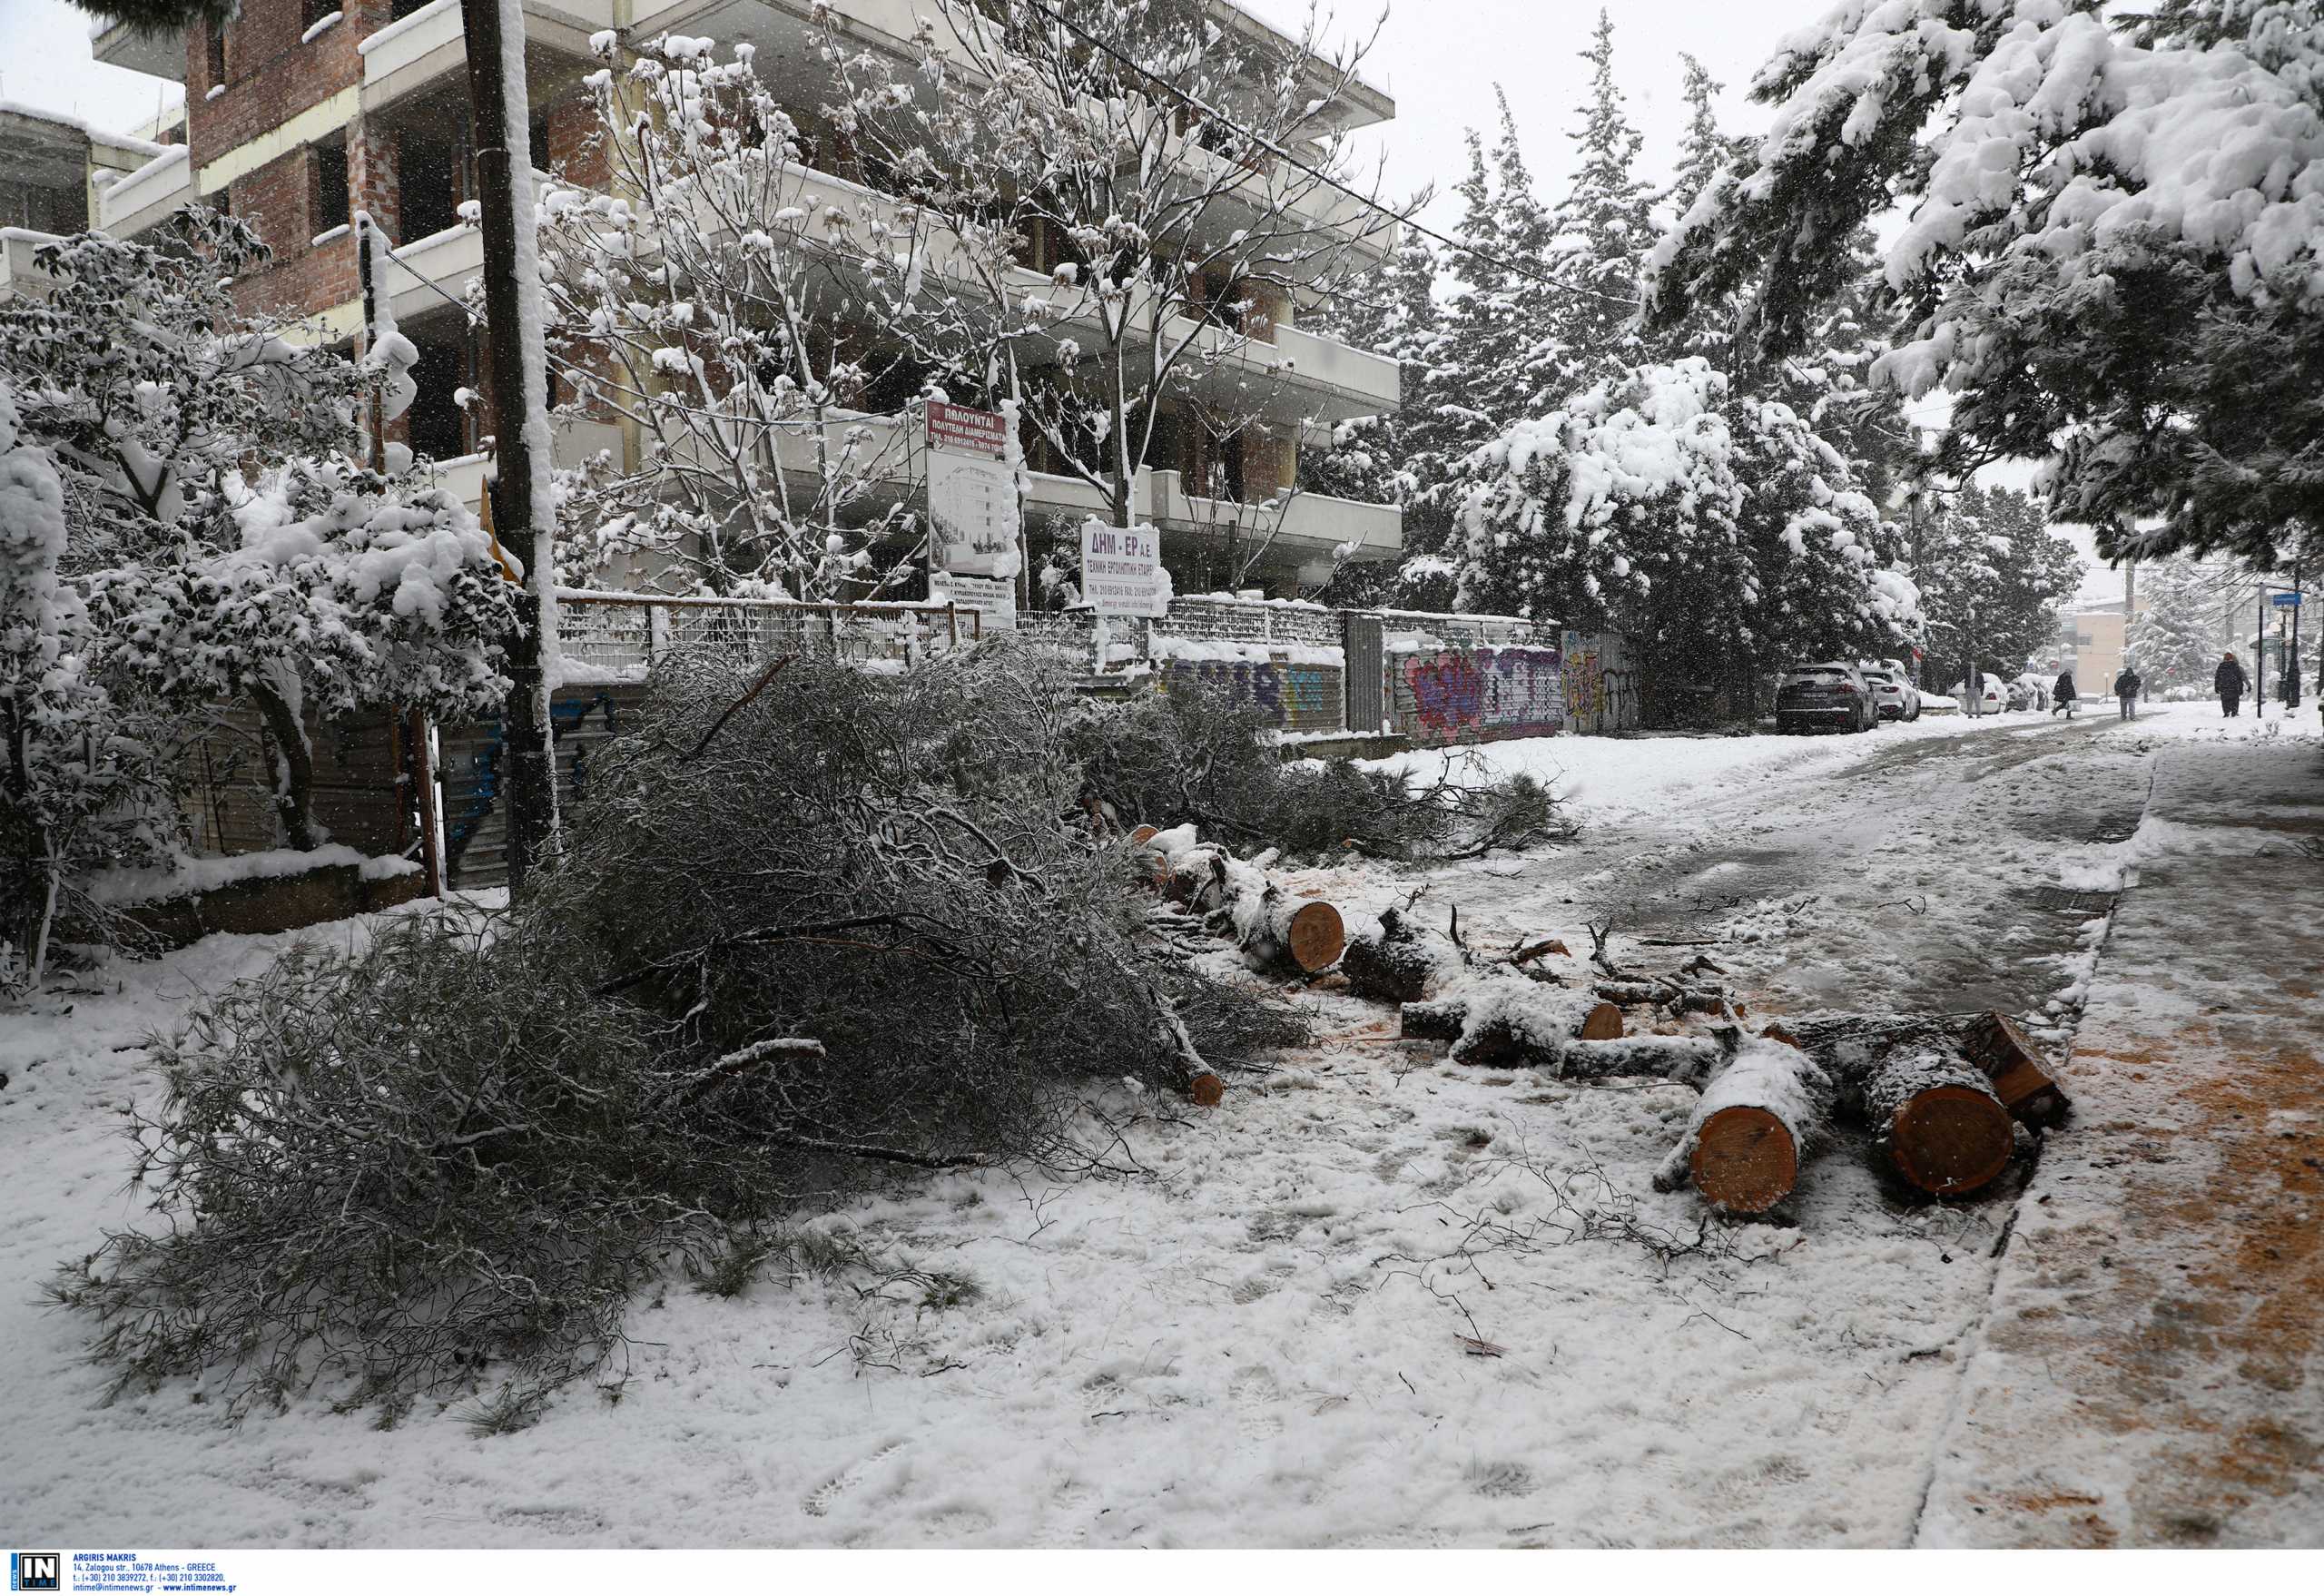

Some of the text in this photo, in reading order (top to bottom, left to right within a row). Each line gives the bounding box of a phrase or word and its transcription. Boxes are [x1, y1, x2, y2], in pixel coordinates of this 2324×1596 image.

[932, 419, 964, 434] ΠΟΛΥΤΕΛΗ
[945, 409, 994, 429] ΠΩΛΟΥΝΤΑΙ
[1092, 533, 1116, 555] ΔΗΜ
[1125, 536, 1137, 557] ΕΡ
